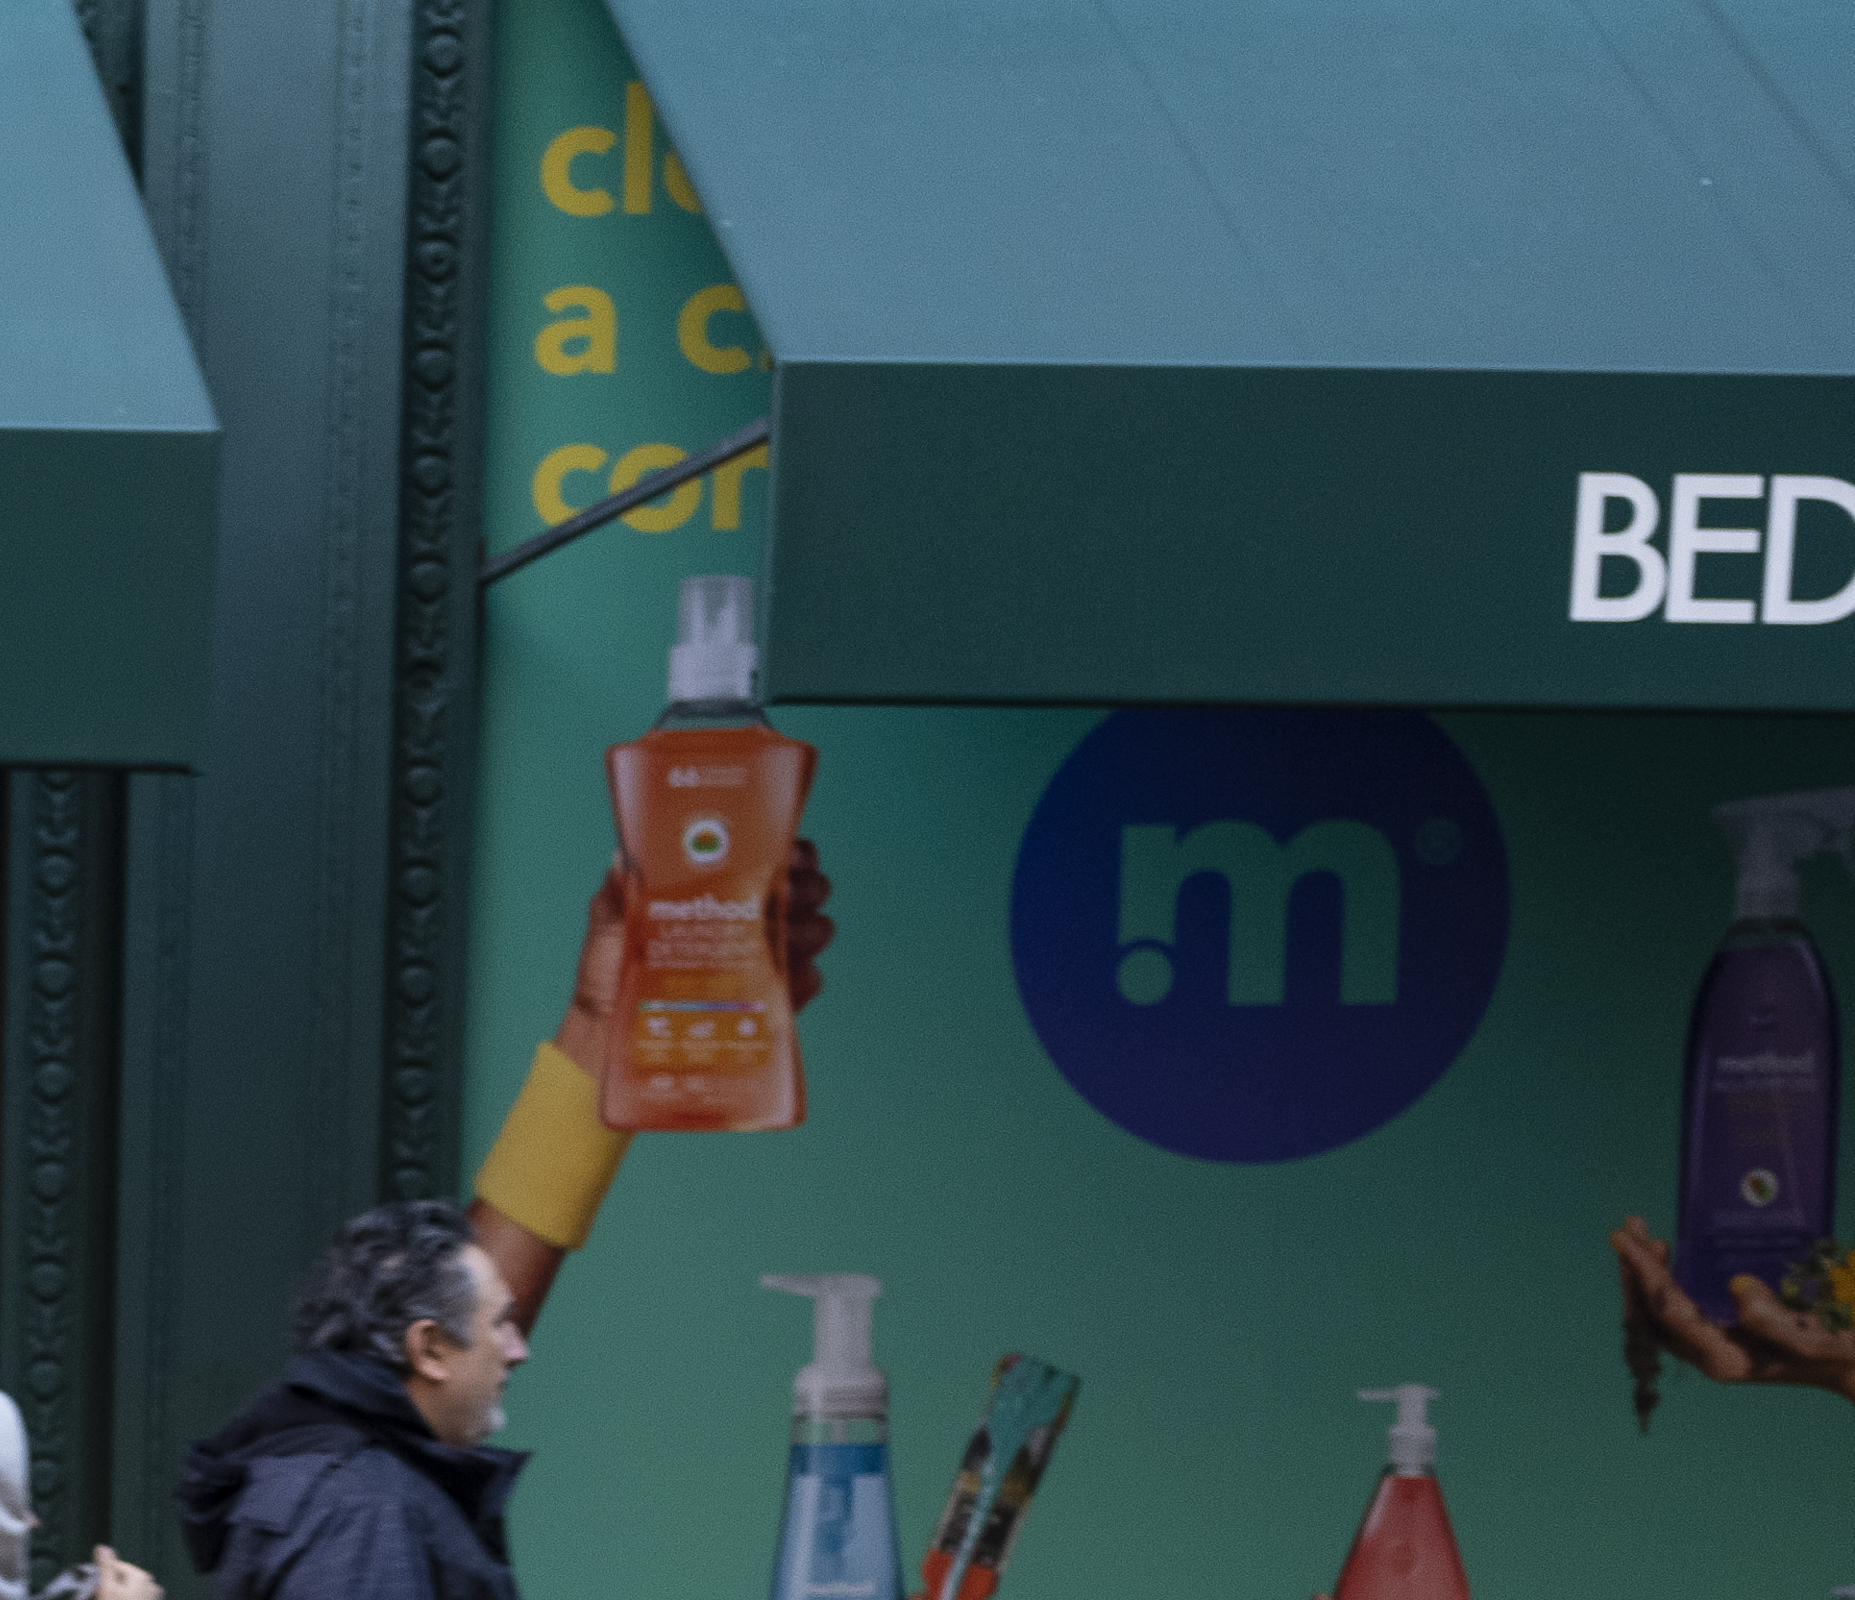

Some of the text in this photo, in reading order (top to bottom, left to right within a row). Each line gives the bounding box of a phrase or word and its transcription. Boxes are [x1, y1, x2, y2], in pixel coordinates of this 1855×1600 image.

[534, 284, 771, 375] a c
[1569, 471, 1855, 625] BED
